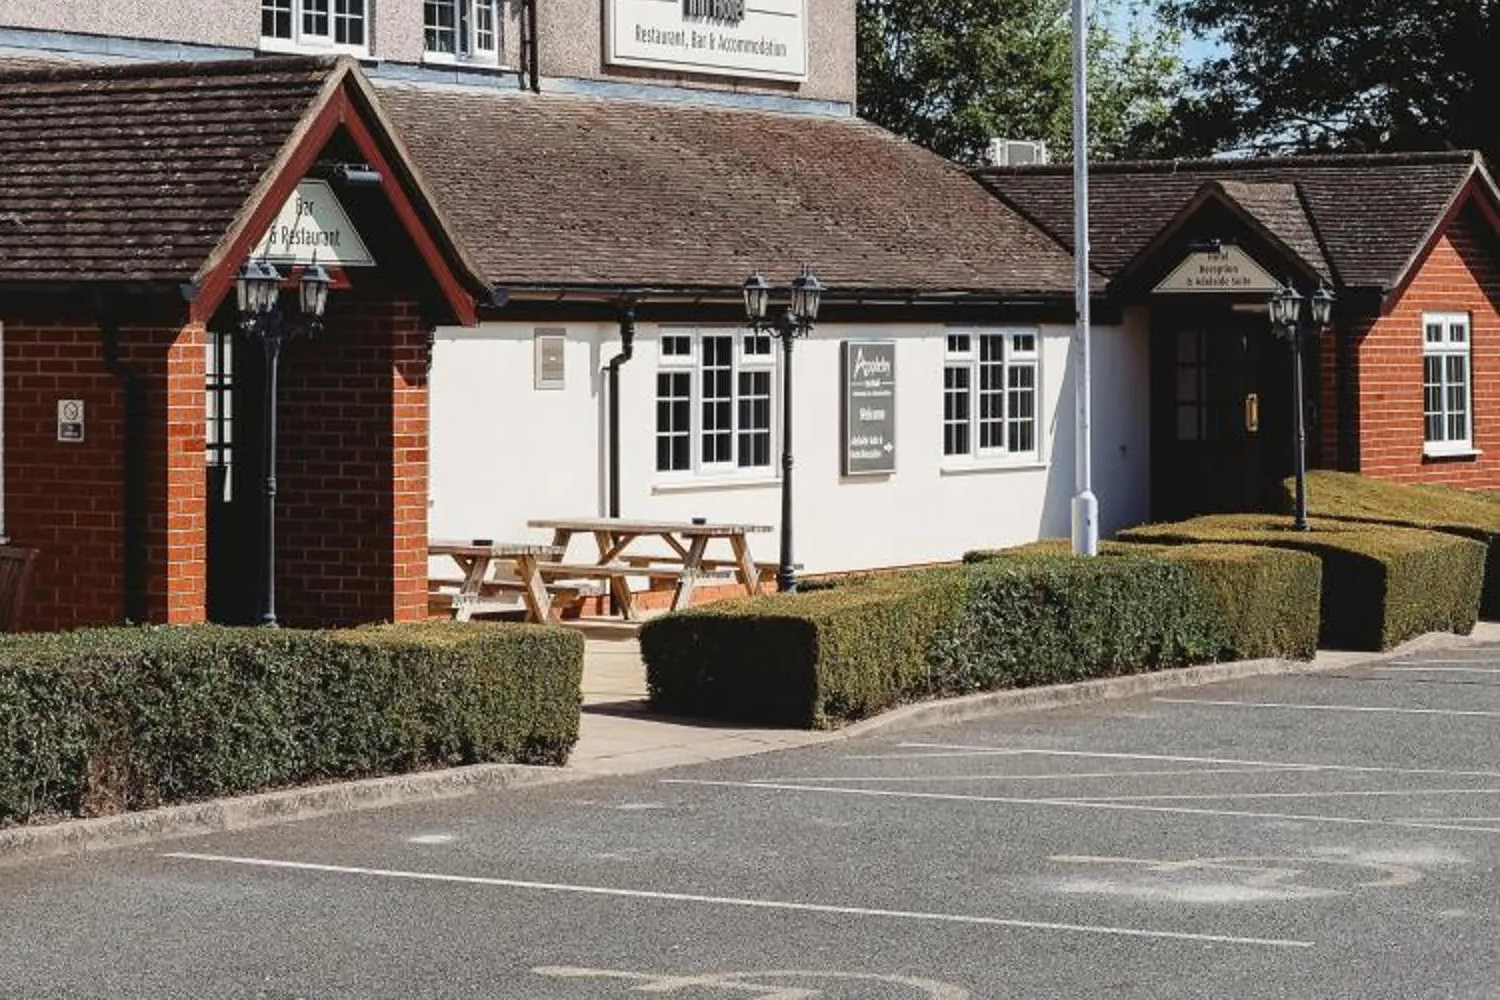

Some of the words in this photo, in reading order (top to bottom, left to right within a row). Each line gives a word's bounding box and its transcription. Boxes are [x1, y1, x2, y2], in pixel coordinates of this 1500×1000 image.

[635, 23, 689, 50] Restaurant,
[691, 30, 707, 49] Bar
[296, 197, 315, 217] Bar
[281, 226, 341, 247] Restaurant
